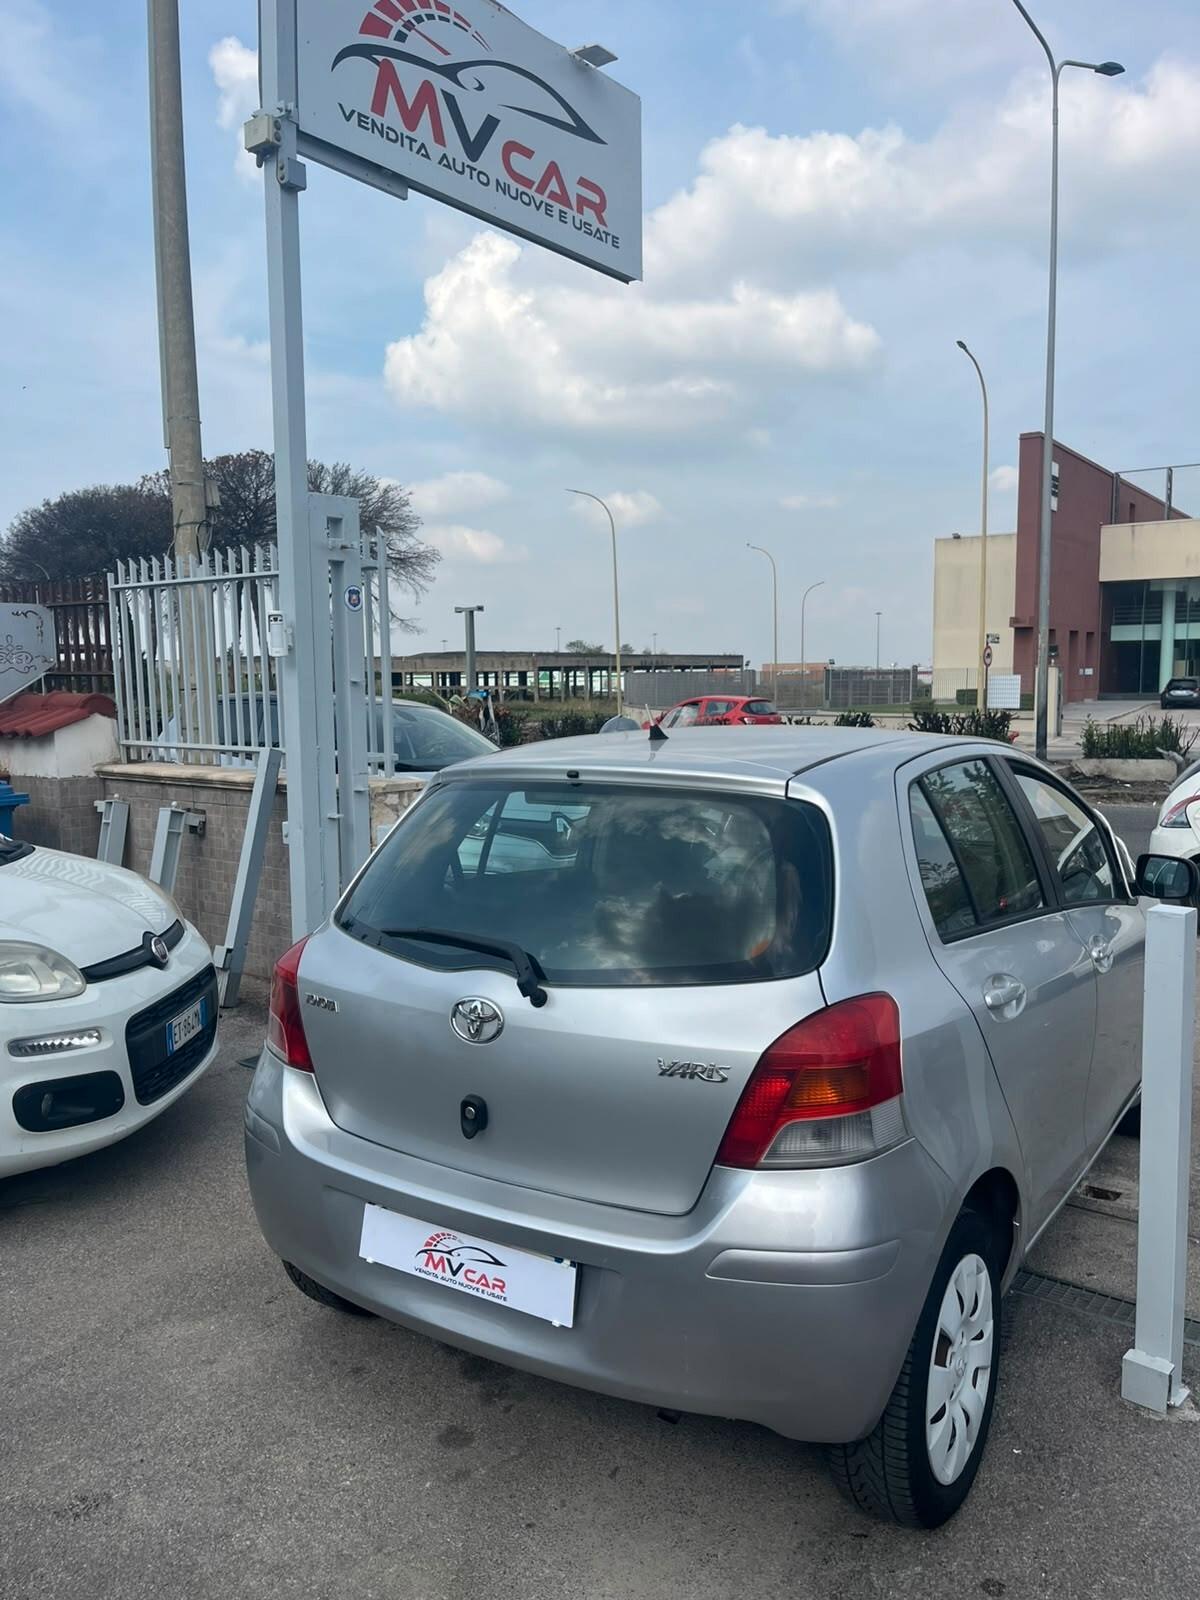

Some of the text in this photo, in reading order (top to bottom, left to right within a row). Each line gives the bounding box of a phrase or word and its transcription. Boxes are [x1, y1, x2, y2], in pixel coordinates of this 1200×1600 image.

[337, 102, 620, 250] VENDITA AUTO NUOVE E USATE
[414, 1266, 439, 1280] VENDITA
[440, 1275, 457, 1286] AUTO
[458, 1281, 480, 1293] NUOVE
[486, 1291, 508, 1302] USATE
